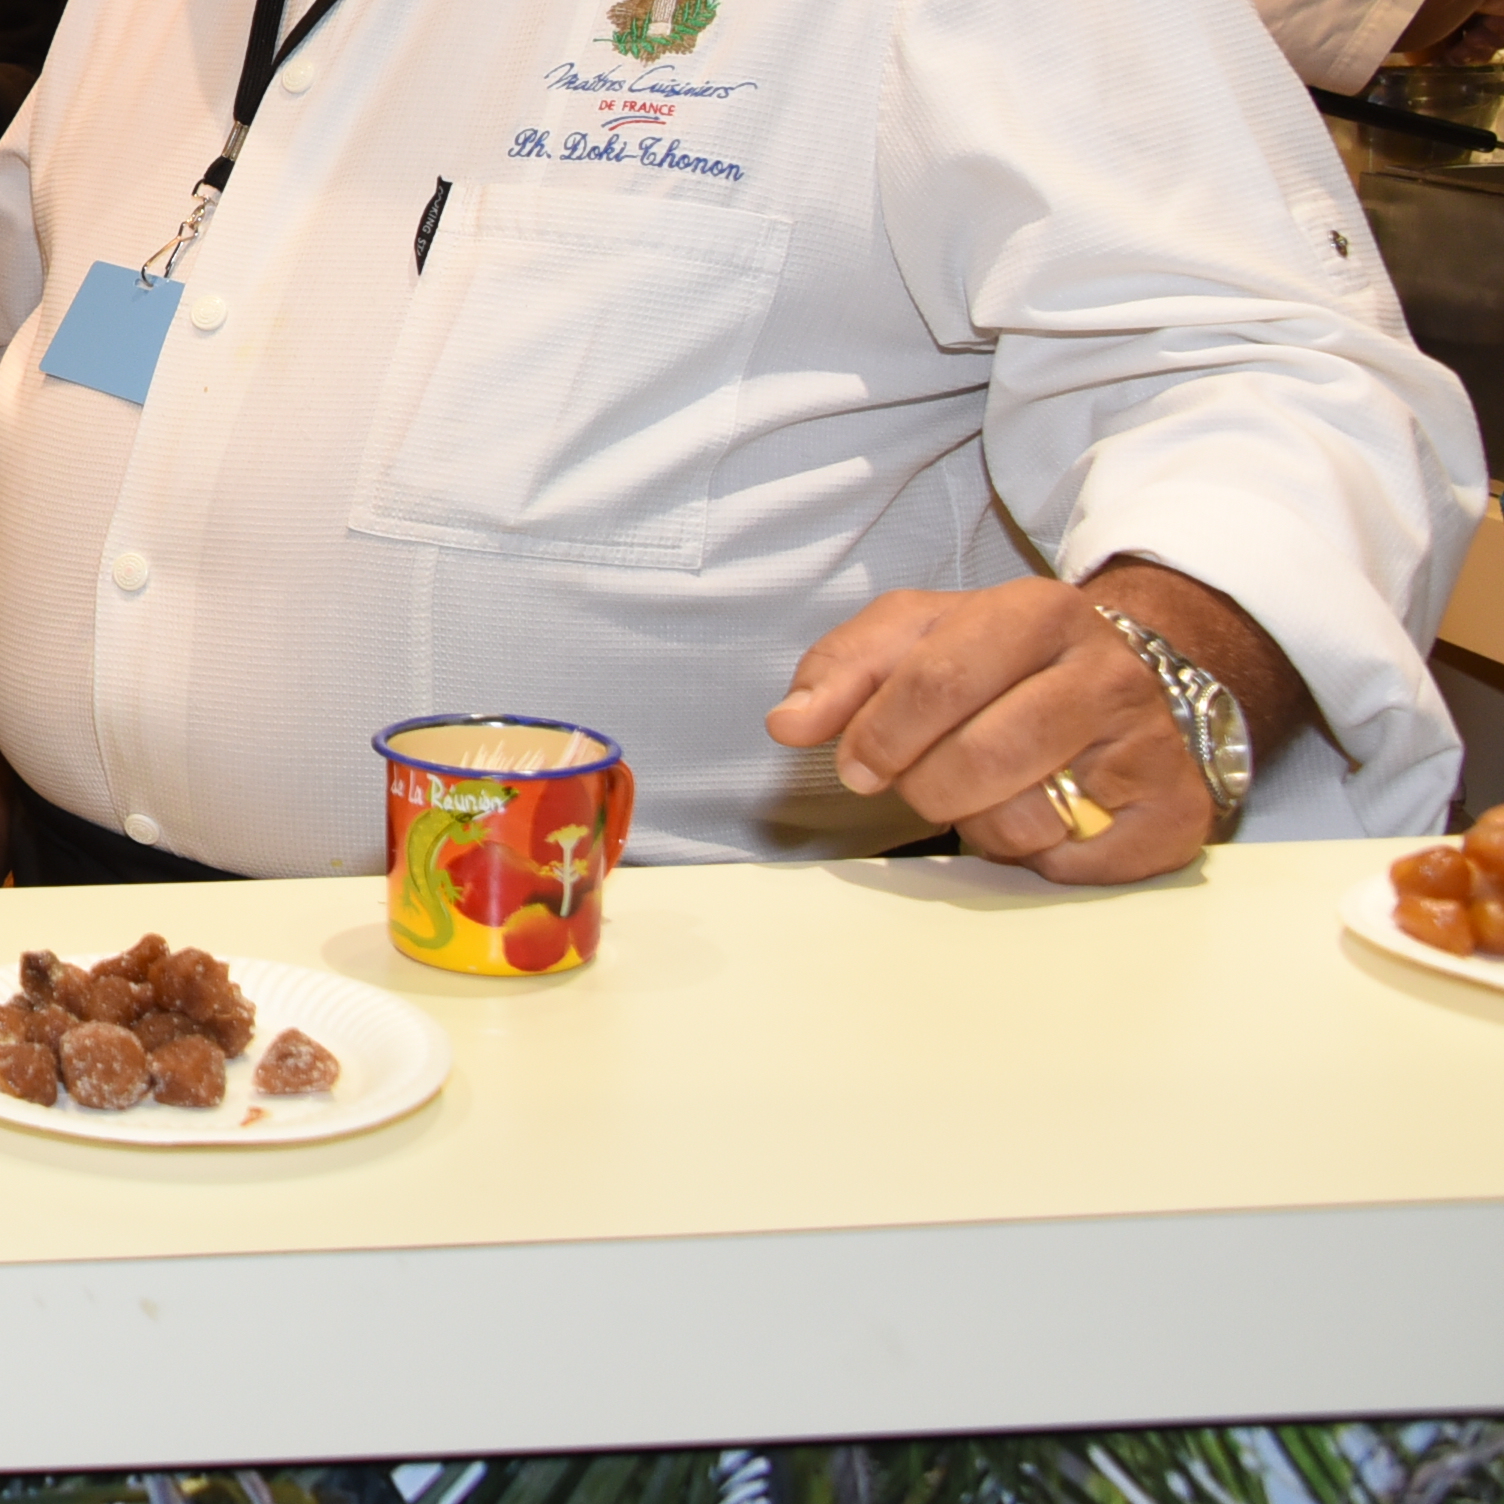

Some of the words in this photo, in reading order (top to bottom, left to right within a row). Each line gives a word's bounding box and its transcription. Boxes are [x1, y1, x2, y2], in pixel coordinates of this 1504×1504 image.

[598, 99, 616, 111] DE
[621, 100, 676, 117] FRANCE
[507, 128, 552, 160] Ph.
[559, 131, 744, 182] Doki-Thonon
[425, 772, 508, 814] Réunion
